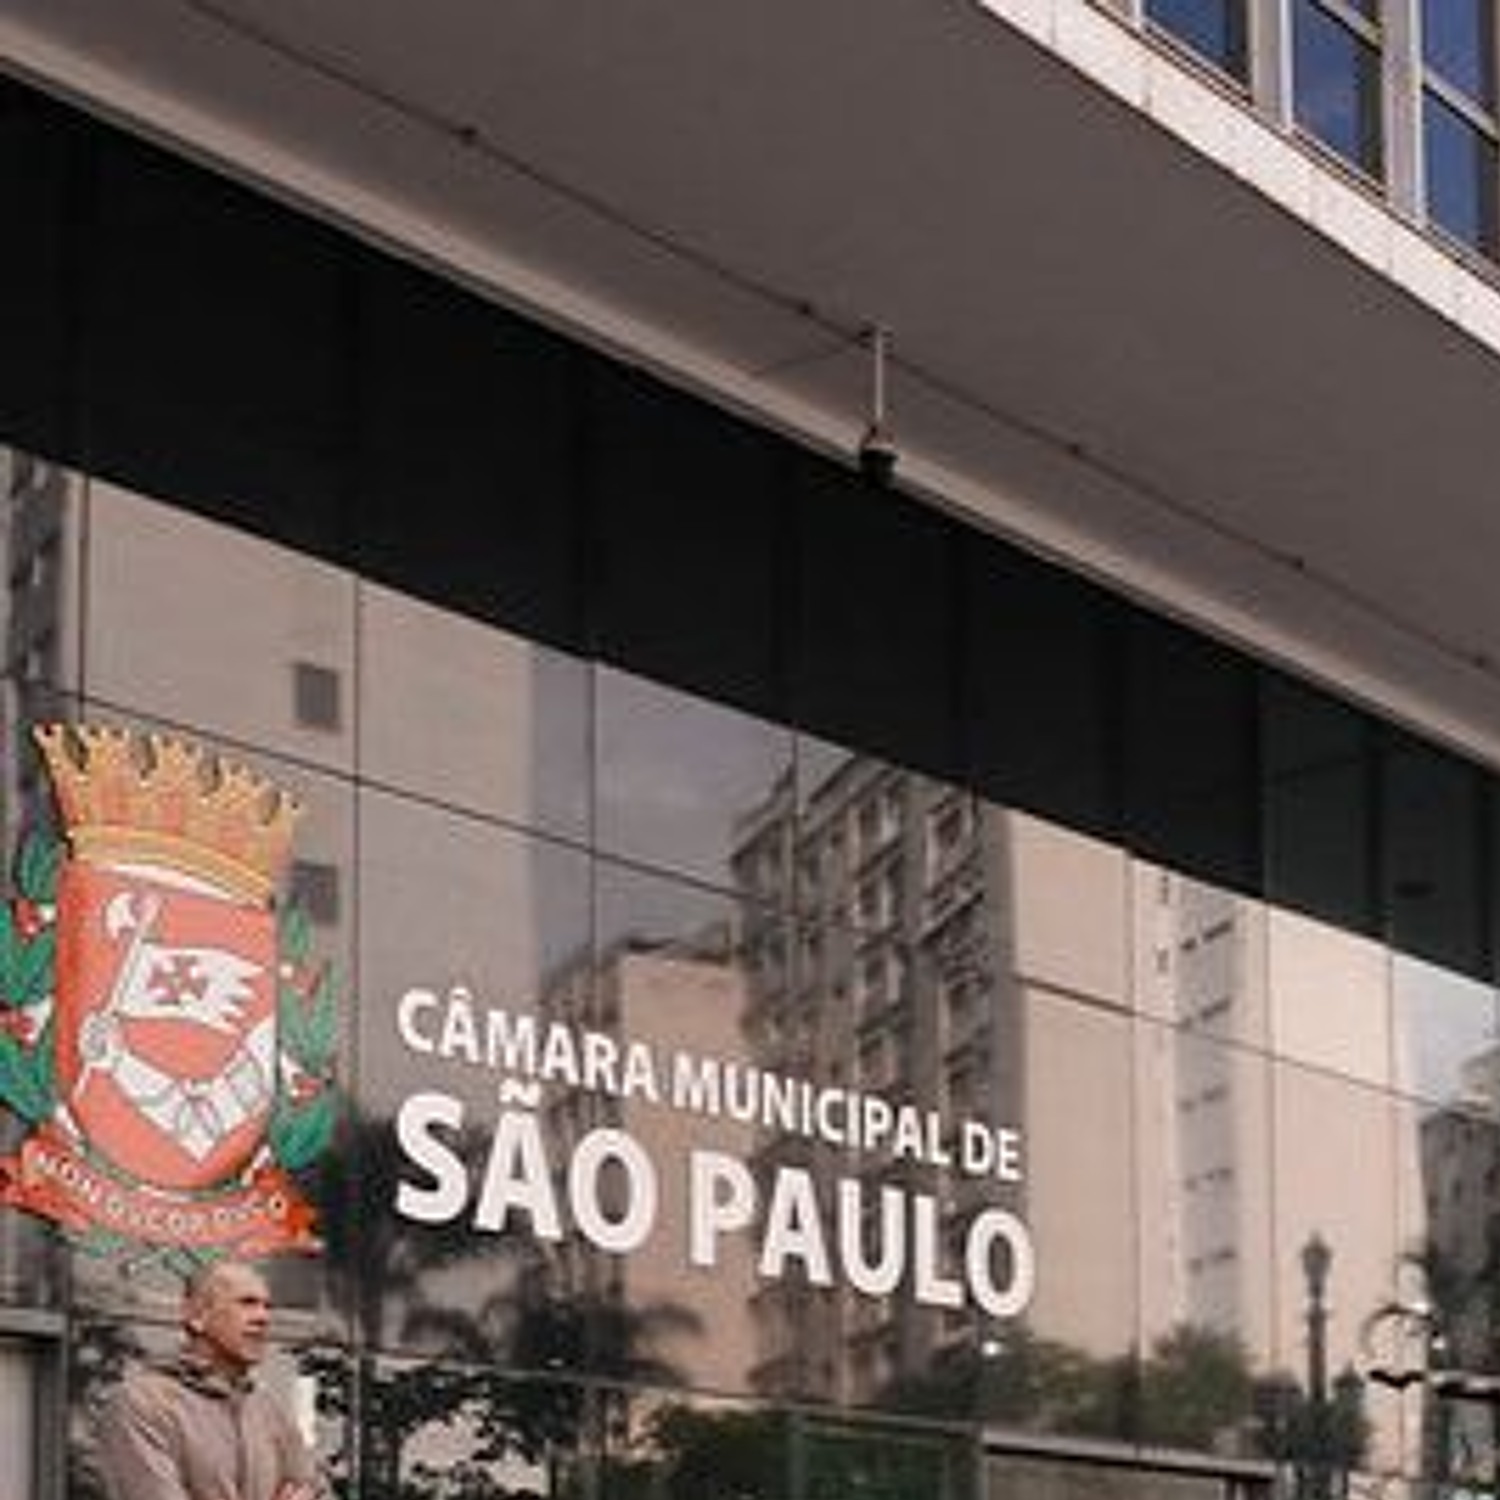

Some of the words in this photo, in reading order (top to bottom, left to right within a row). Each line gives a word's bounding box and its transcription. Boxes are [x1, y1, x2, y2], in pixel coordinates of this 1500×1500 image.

[397, 985, 661, 1103] CÂMARA
[671, 1051, 952, 1166] MUNICIPAL
[962, 1119, 1023, 1182] DE
[396, 1074, 660, 1255] SÃO
[688, 1148, 1036, 1318] PAULO
